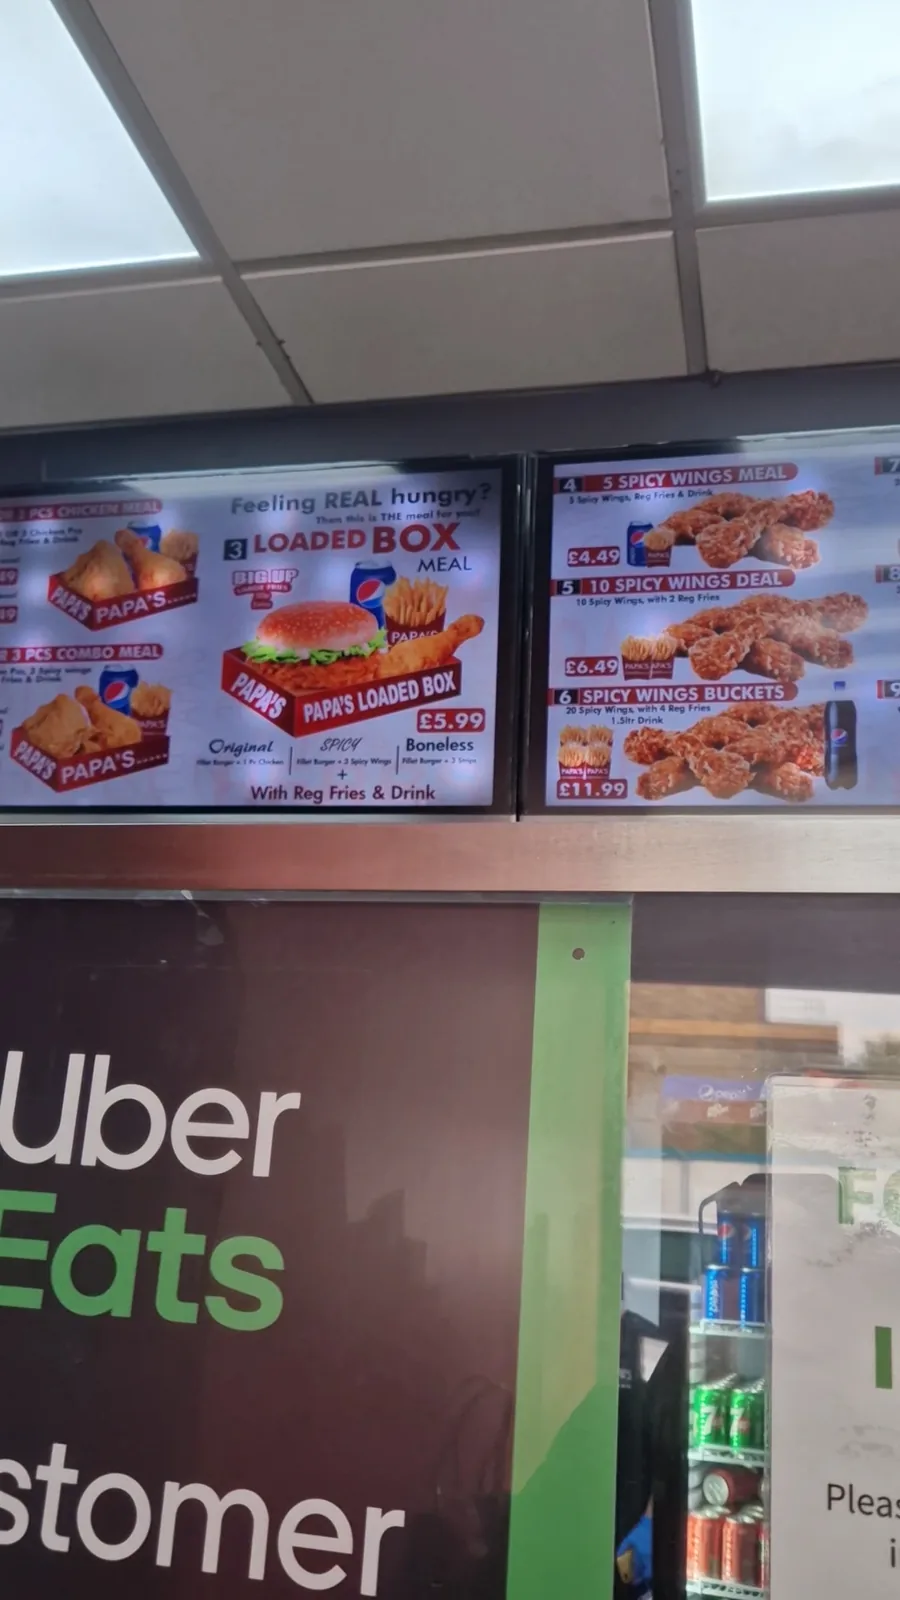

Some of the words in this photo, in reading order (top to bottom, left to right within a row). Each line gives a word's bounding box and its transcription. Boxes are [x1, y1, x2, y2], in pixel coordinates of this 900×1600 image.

[563, 478, 577, 492] 4
[603, 476, 613, 489] 5
[618, 473, 666, 489] SPICY
[671, 469, 732, 486] WINGS
[738, 466, 787, 481] MEAL
[231, 494, 316, 515] Feeling
[324, 489, 382, 510] REAL
[391, 482, 492, 507] hungry?
[577, 495, 598, 504] Spicy
[654, 492, 675, 500] Fries
[688, 489, 713, 498] Drink
[57, 503, 119, 517] CHICKEN
[121, 500, 158, 513] MEAL
[380, 512, 402, 520] THE
[406, 510, 434, 520] meal
[230, 541, 242, 559] 3
[254, 528, 366, 553] LOADED
[372, 522, 461, 554] BOX
[417, 556, 472, 572] MEAL
[568, 548, 620, 565] £4.49
[562, 582, 574, 594] 5
[590, 580, 610, 593] 10
[614, 576, 662, 592] SPICY
[668, 573, 731, 590] WINGS
[734, 572, 783, 588] DEAL
[96, 591, 166, 624] PAPA'S
[576, 598, 587, 606] 10
[588, 598, 612, 606] Spicy
[678, 594, 695, 604] Reg
[698, 594, 720, 602] Fries
[13, 650, 20, 660] 3
[25, 648, 52, 660] PCS
[57, 646, 114, 660] COMBO
[118, 644, 160, 658] MEAL
[566, 660, 618, 675] £6.49
[230, 672, 287, 719] PAPA'S
[303, 693, 355, 723] PAPA'S
[358, 680, 420, 712] LOADED
[423, 670, 456, 698] BOX
[559, 690, 572, 704] 6
[582, 688, 632, 704] SPICY
[635, 687, 699, 702] WINGS
[704, 684, 785, 700] BUCKETS
[566, 706, 577, 715] 20
[579, 706, 602, 716] Spicy
[637, 704, 658, 713] with
[660, 704, 666, 713] 4
[668, 704, 685, 714] Reg
[688, 704, 712, 712] Fries
[419, 712, 484, 730] £5.99
[638, 716, 664, 725] Drink
[208, 738, 274, 758] Original
[320, 737, 362, 752] SPICY
[406, 736, 474, 752] Boneless
[13, 740, 57, 780] PAPA'S
[61, 750, 136, 785] PAPA'S
[351, 758, 368, 766] Spicy
[370, 758, 392, 766] Wings
[250, 784, 288, 800] With
[294, 786, 324, 804] Reg
[330, 785, 366, 800] Fries
[372, 785, 385, 800] &
[391, 784, 436, 800] Drink
[558, 782, 626, 797] £11.99
[0, 1050, 301, 1177] Uber
[0, 1189, 285, 1331] Eats
[0, 1442, 406, 1597] stomer
